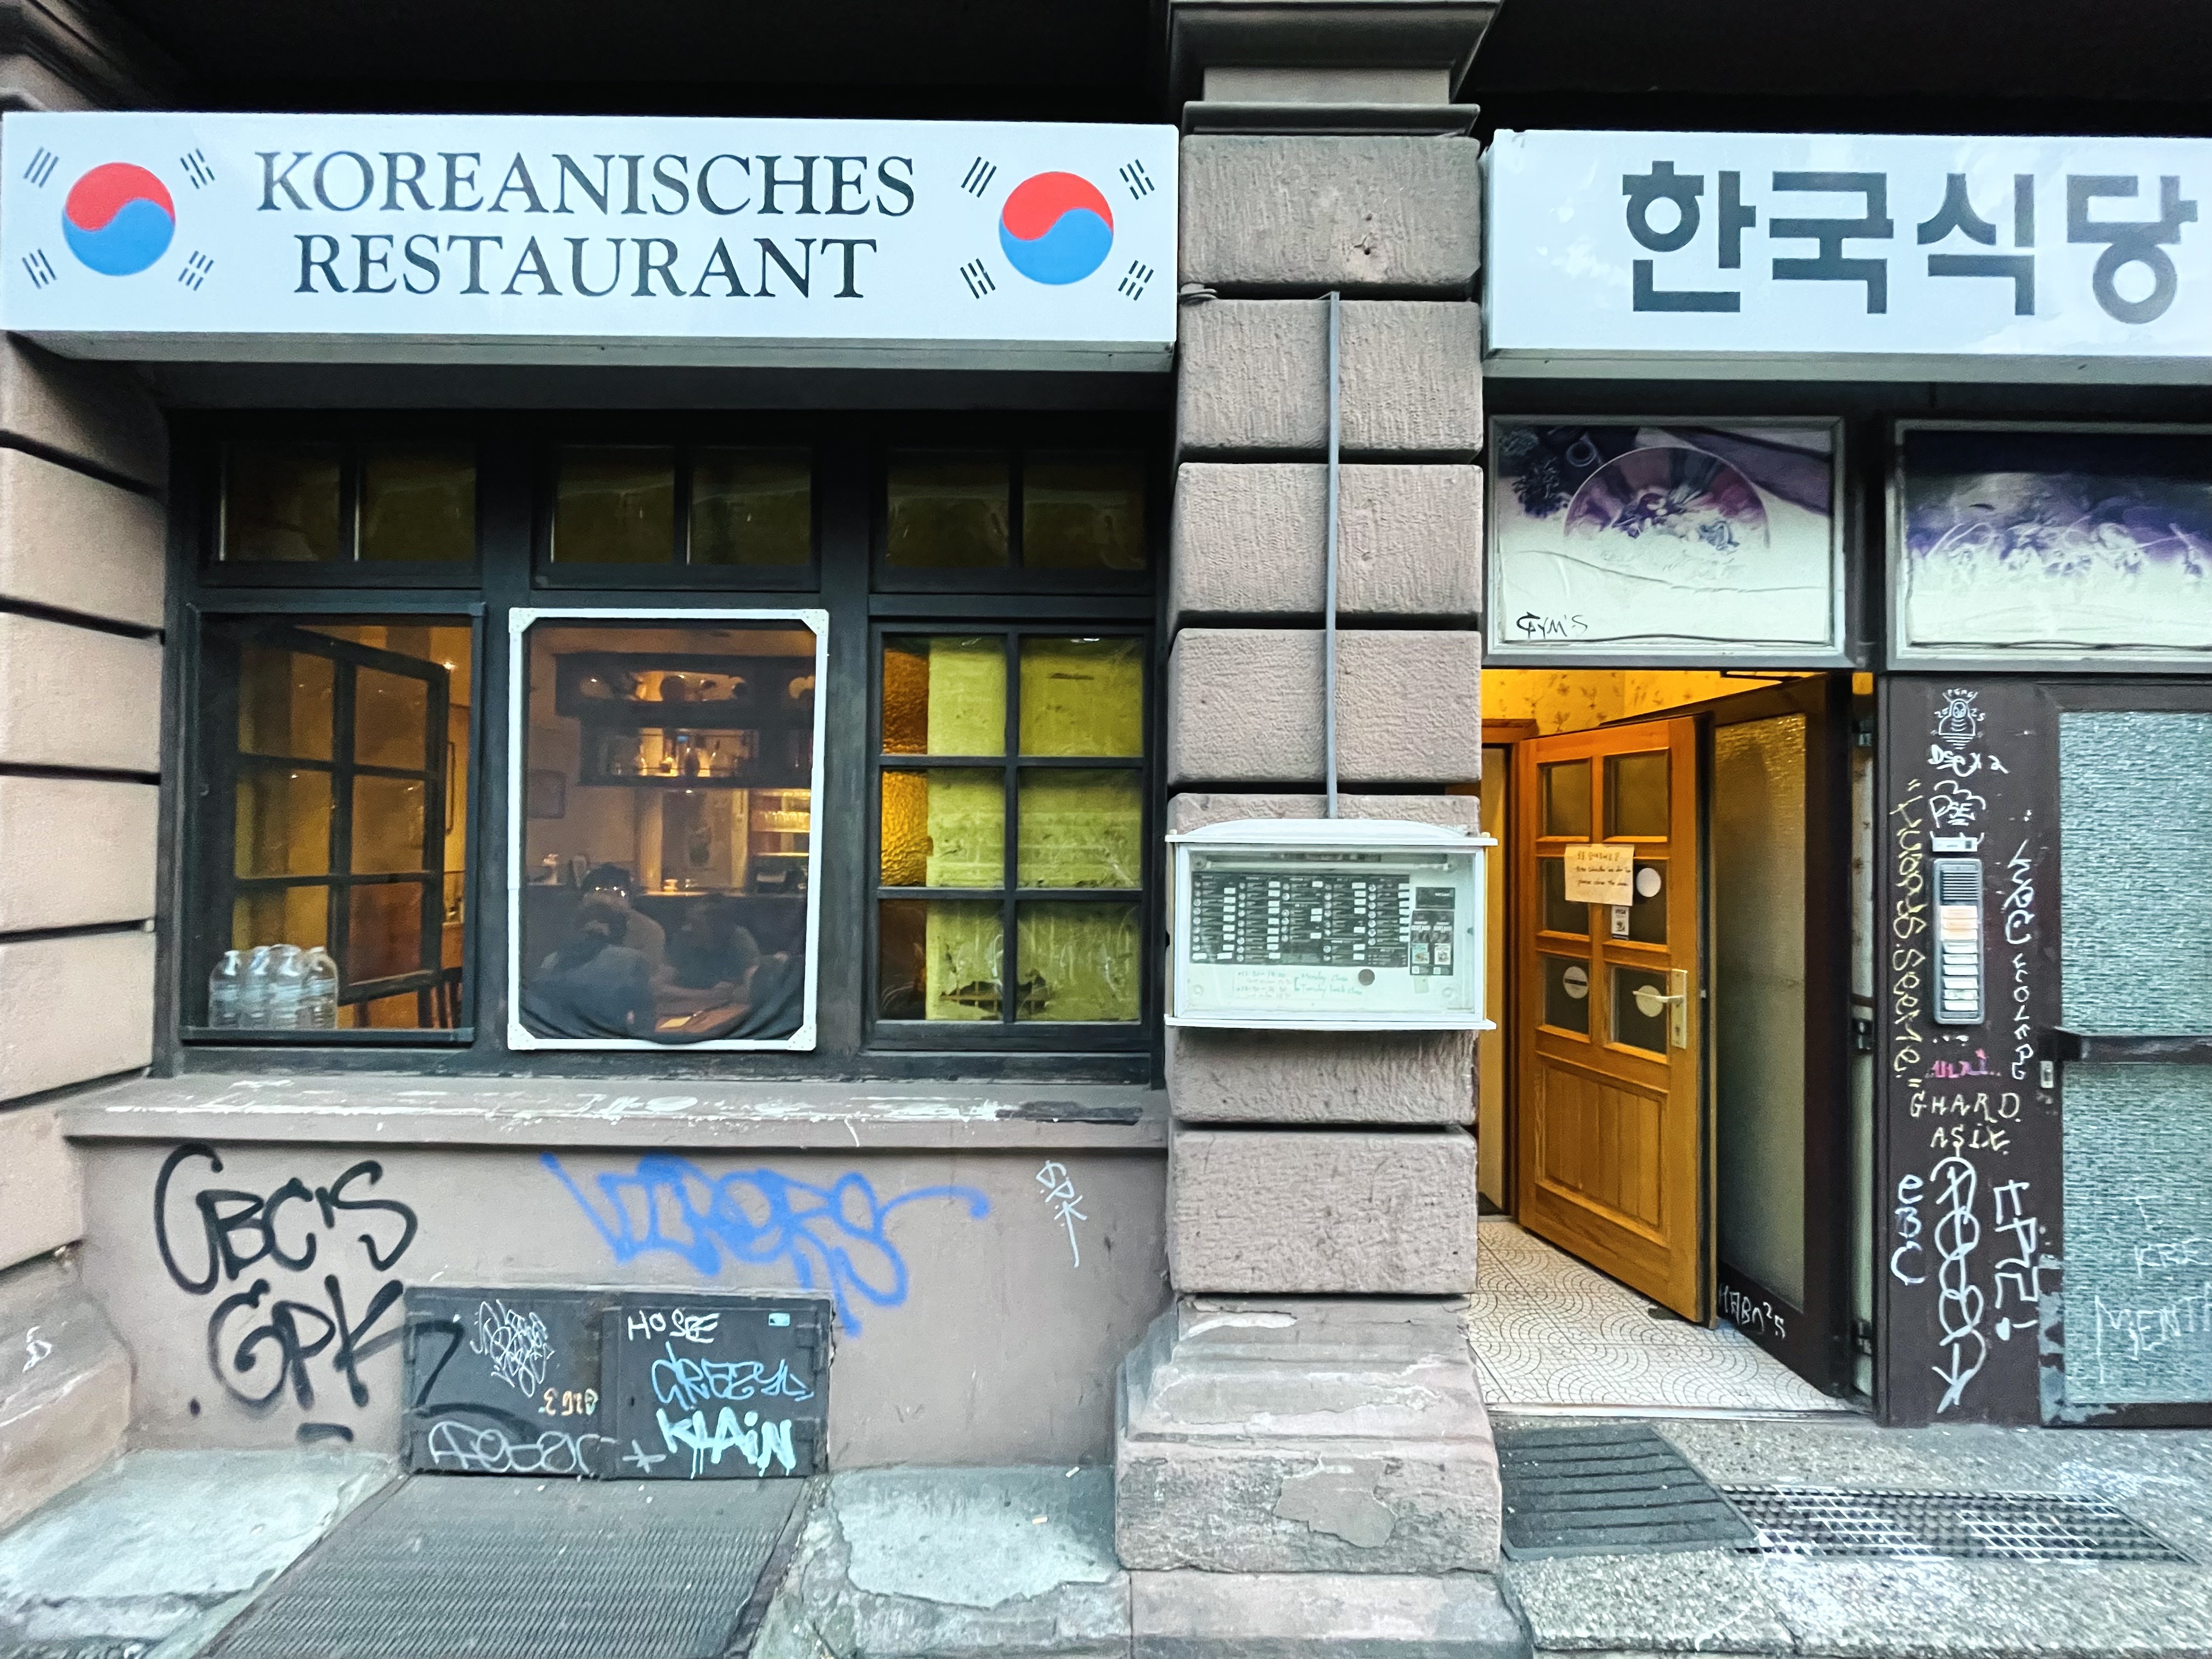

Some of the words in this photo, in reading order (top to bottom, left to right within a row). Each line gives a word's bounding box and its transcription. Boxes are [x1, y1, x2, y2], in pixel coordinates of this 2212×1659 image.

[255, 151, 915, 217] KOREANISCHES
[293, 234, 877, 299] RESTAURANT
[1622, 160, 2198, 325] 한국식당
